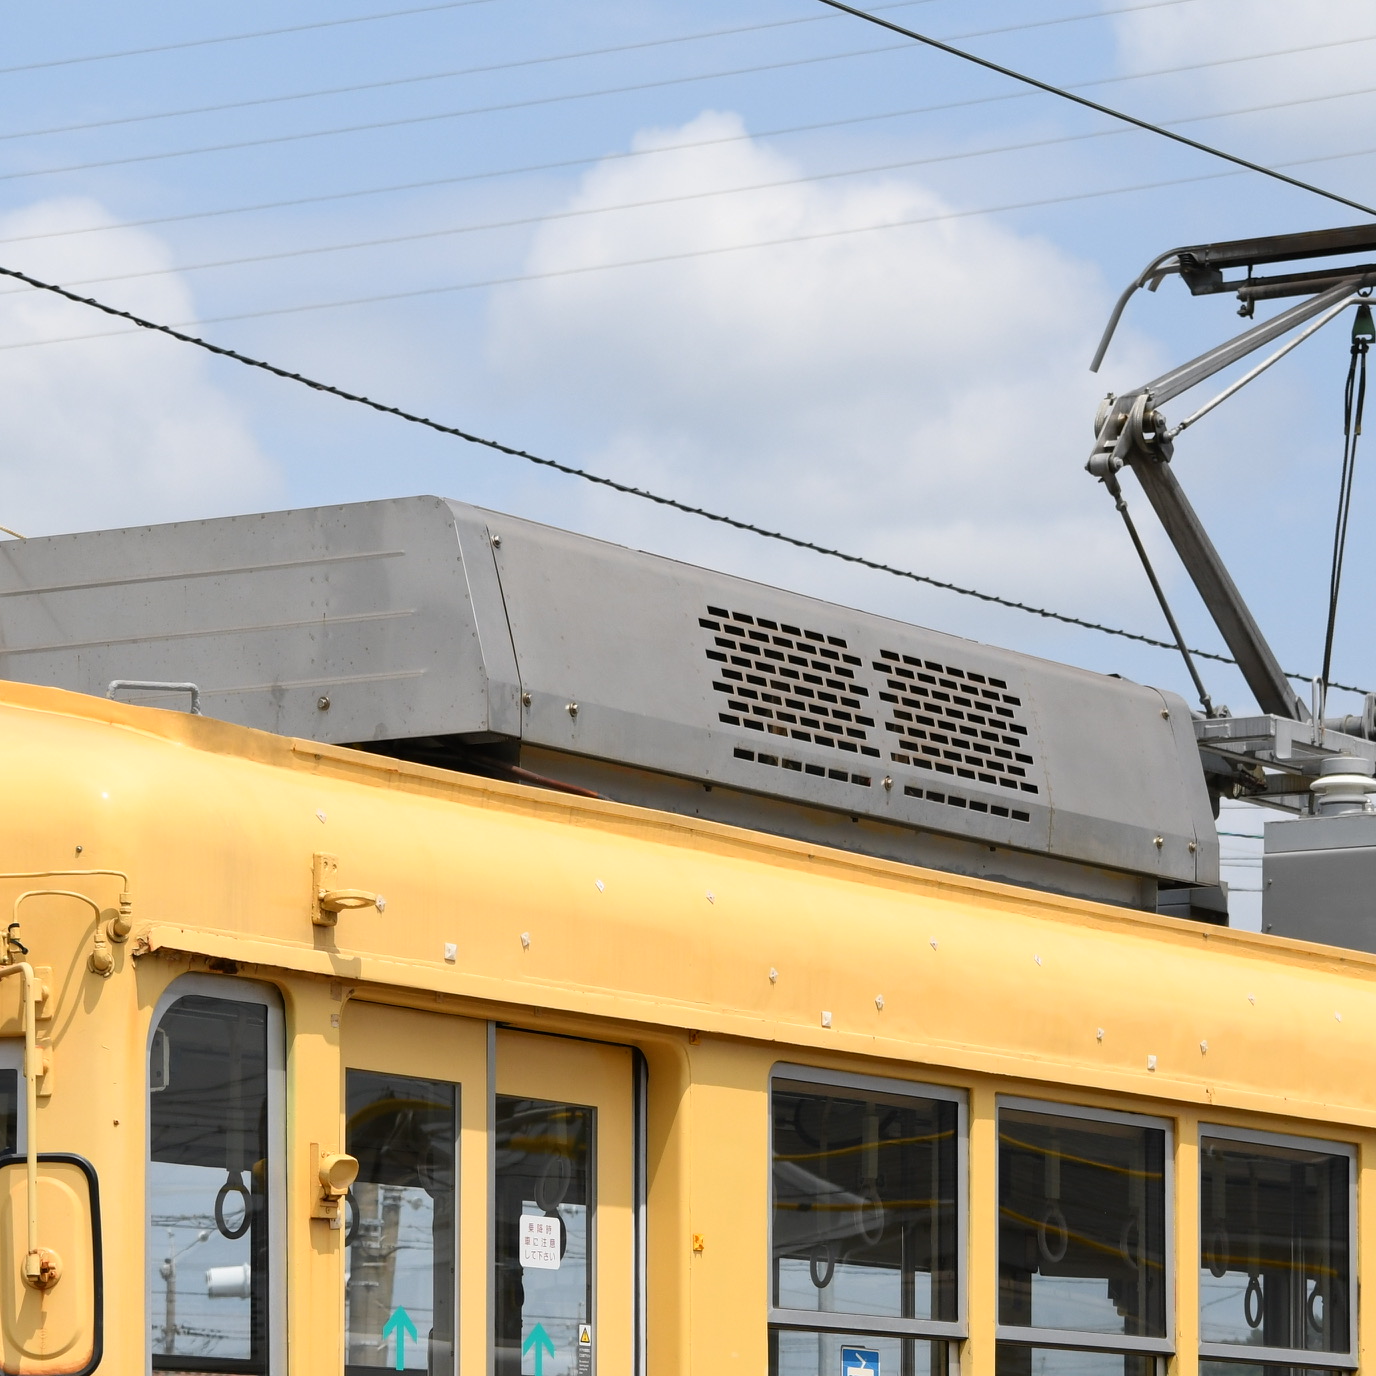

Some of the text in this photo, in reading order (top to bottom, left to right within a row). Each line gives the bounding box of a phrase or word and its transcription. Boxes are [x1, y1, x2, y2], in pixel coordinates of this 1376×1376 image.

[524, 1250, 556, 1261] して下さい
